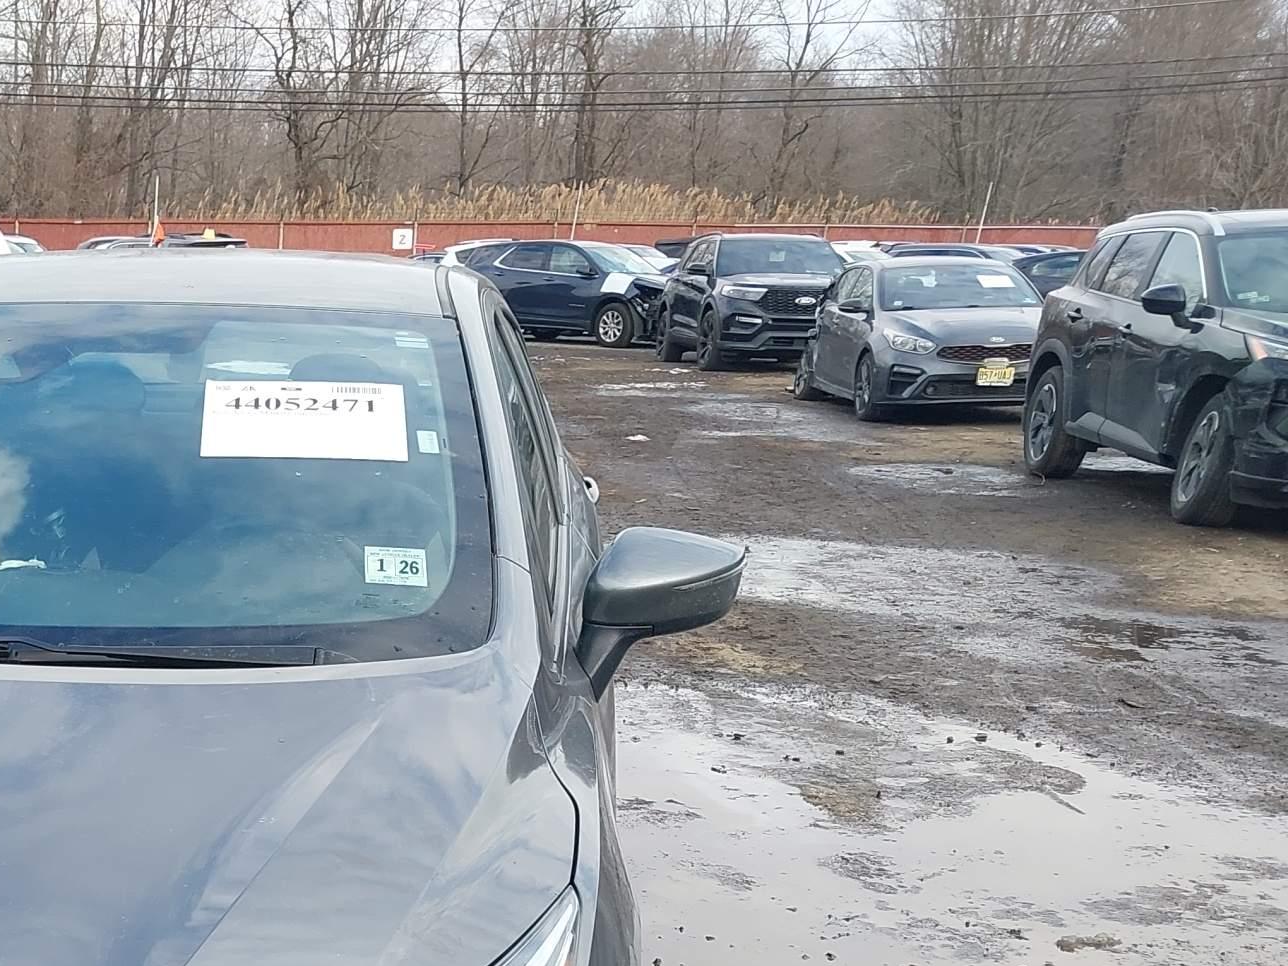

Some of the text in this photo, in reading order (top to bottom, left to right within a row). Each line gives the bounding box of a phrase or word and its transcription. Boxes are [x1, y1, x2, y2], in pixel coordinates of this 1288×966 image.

[399, 234, 407, 245] 2
[224, 396, 375, 412] 44052471
[376, 558, 419, 575] 1 26
